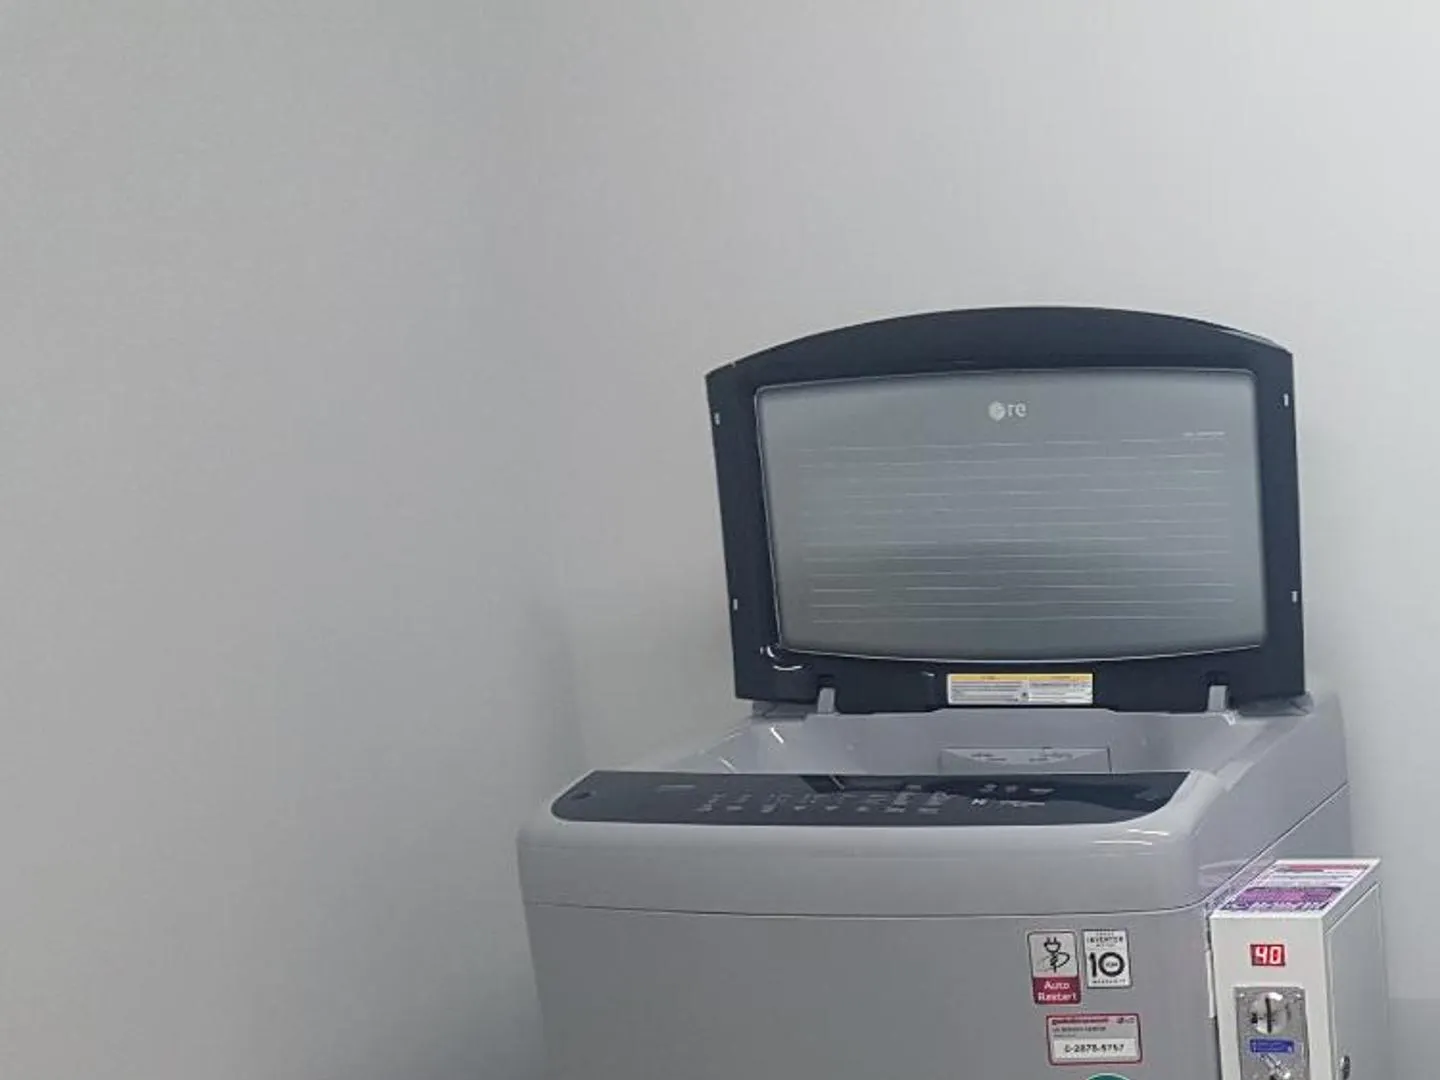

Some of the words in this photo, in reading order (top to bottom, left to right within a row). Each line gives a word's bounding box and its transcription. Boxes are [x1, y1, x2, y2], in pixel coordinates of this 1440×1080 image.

[1255, 946, 1282, 965] 40
[1089, 951, 1125, 977] 10
[1043, 980, 1071, 990] Auto
[1037, 991, 1078, 1002] Restart
